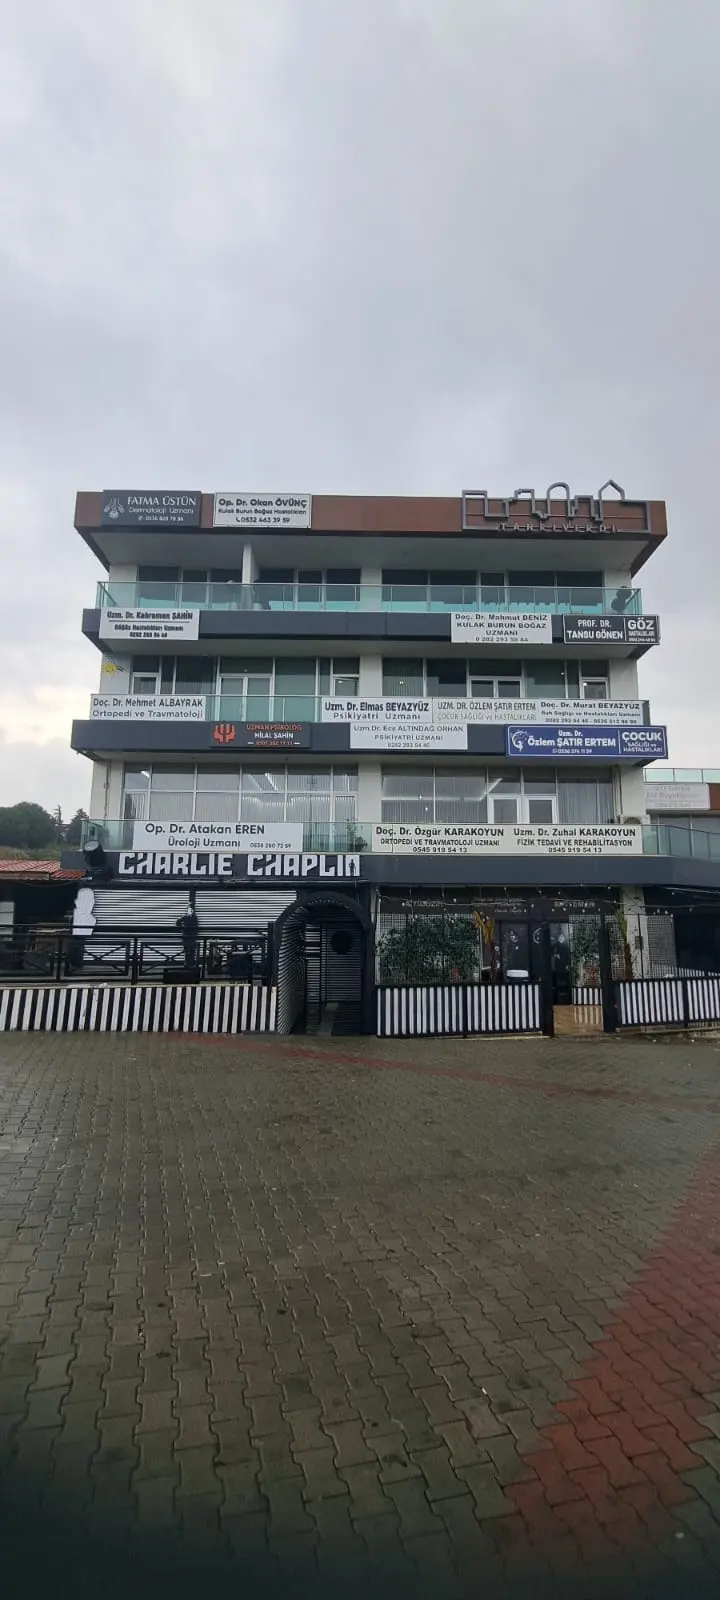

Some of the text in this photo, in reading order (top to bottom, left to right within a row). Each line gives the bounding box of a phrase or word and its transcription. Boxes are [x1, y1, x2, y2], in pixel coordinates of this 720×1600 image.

[128, 495, 196, 506] FATMA ÜSTÜN
[218, 497, 307, 508] Op. Dr. Okan ÖVÜNÇ
[107, 610, 193, 620] Uzm. Dr. Kahraman ŞAHİN
[518, 621, 548, 629] BOĞAZ
[577, 619, 612, 628] PROF. DR.
[627, 617, 655, 631] GÖZ
[566, 630, 594, 640] TANSU
[595, 628, 624, 640] GÖNEN
[93, 698, 204, 708] Doç. Dr. Mehmet ALBAYRAK
[324, 700, 430, 712] Uzm. Dr. Elmas BEYAZYÜZ
[437, 699, 537, 713] UZM. DR. ÖZLEM ŞATIR ERTEM
[540, 701, 559, 709] Doç.
[573, 701, 597, 709] Murat
[92, 709, 132, 718] Ortopedi
[147, 710, 203, 719] Travmatoloji
[333, 712, 379, 721] Psikiyatri
[437, 712, 459, 720] ÇOCUK
[460, 711, 484, 720] SAĞLIĞI
[494, 713, 537, 721] HASTALIKLARI
[247, 723, 269, 731] UZMAN
[397, 724, 436, 732] ALTINDAĞ
[436, 725, 464, 733] ORHAN
[254, 731, 294, 740] HİLAL ŞAHİN
[374, 733, 414, 741] PSİKİYATRİ
[558, 729, 584, 738] Uzm. Dr.
[621, 731, 662, 744] ÇOCUK
[527, 735, 617, 749] Özlem ŞATIR ERTEM
[627, 741, 649, 749] SAĞLIĞI
[145, 823, 265, 835] Op. Dr. Atakan EREN
[375, 826, 504, 838] Doç. Dr. Özgür KARAKOYUN
[513, 828, 636, 838] Uzm. Dr. Zuhal KARAKOYUN
[168, 836, 241, 848] Üroloji Uzmanı
[380, 838, 413, 846] ORTOPEDİ
[424, 838, 473, 846] TRAVMATOLOJİ
[516, 838, 536, 846] FİZİK
[537, 838, 562, 846] TEDAVİ
[573, 838, 633, 847] REHABİLİTASYON
[118, 852, 361, 878] CHARLIE CHAPLIN
